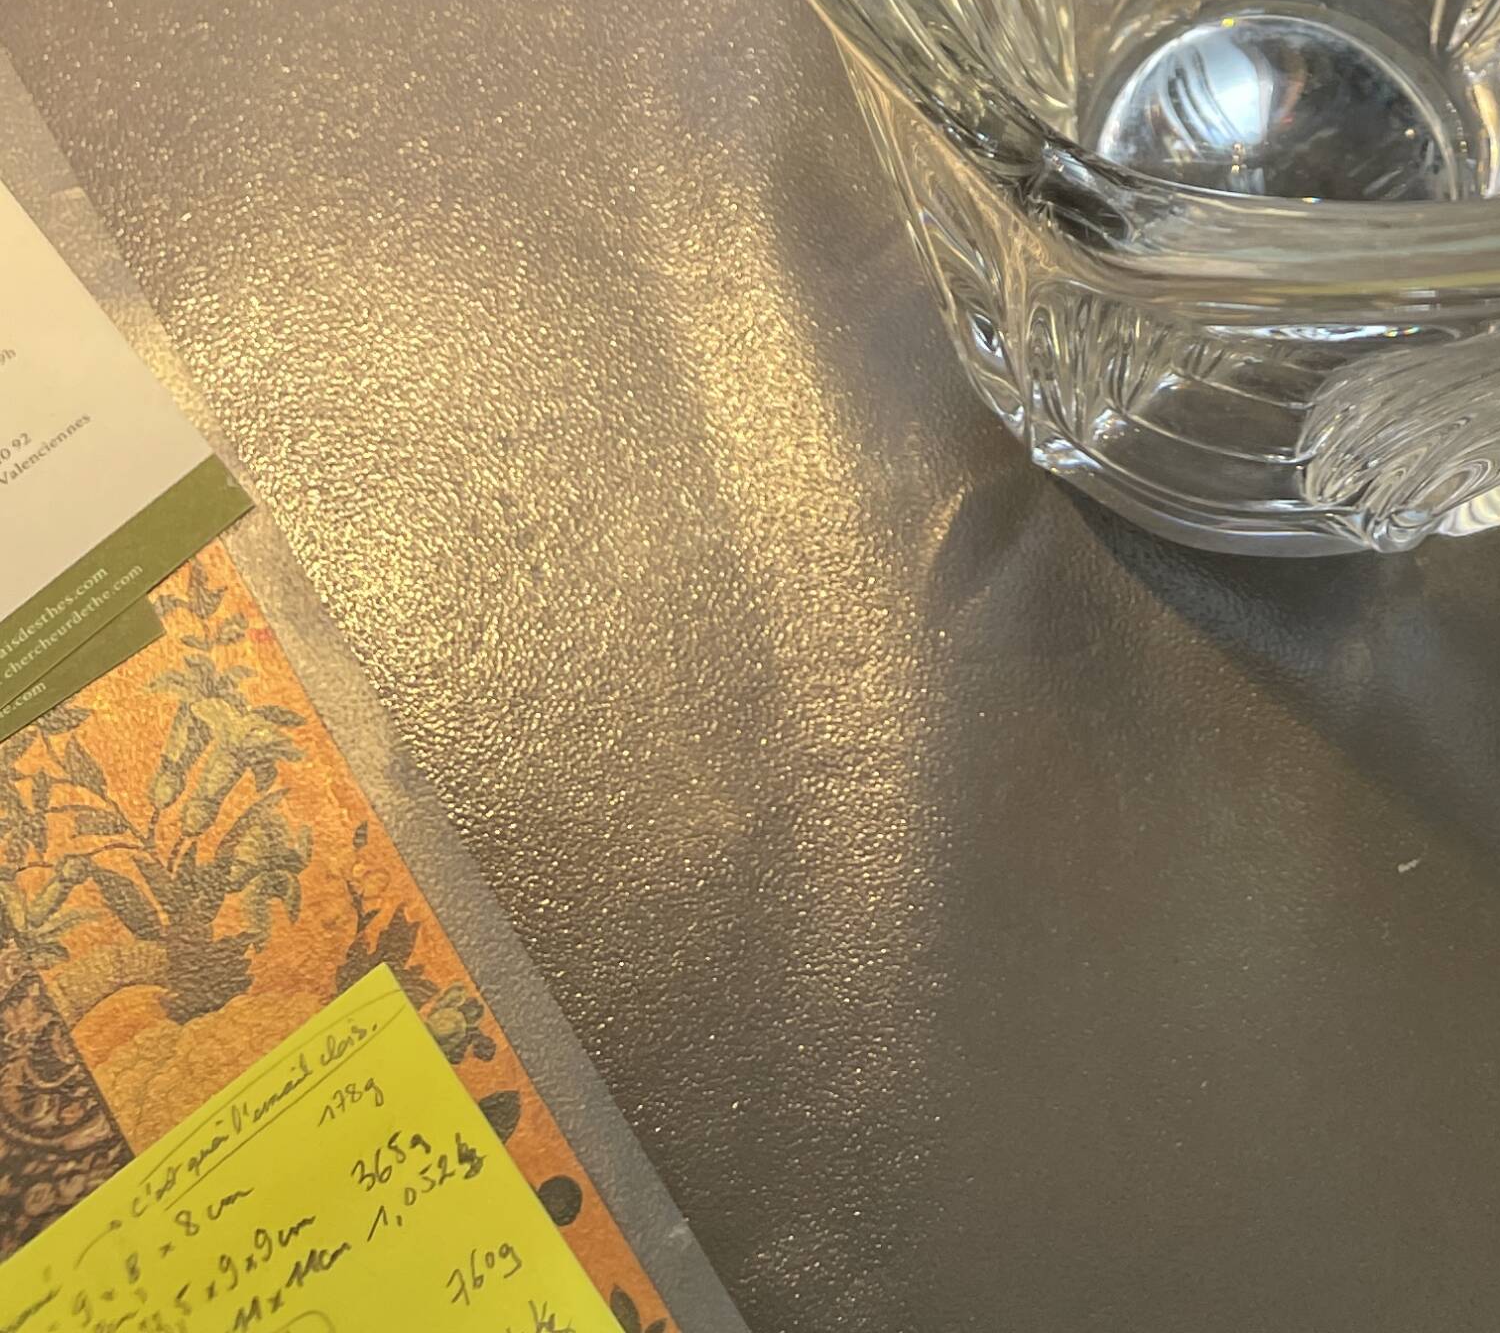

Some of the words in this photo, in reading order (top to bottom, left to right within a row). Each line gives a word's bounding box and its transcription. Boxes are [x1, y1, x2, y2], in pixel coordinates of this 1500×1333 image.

[11, 432, 32, 450] 92
[3, 563, 144, 680] chercheurdethe.com
[317, 1076, 385, 1128] 178g
